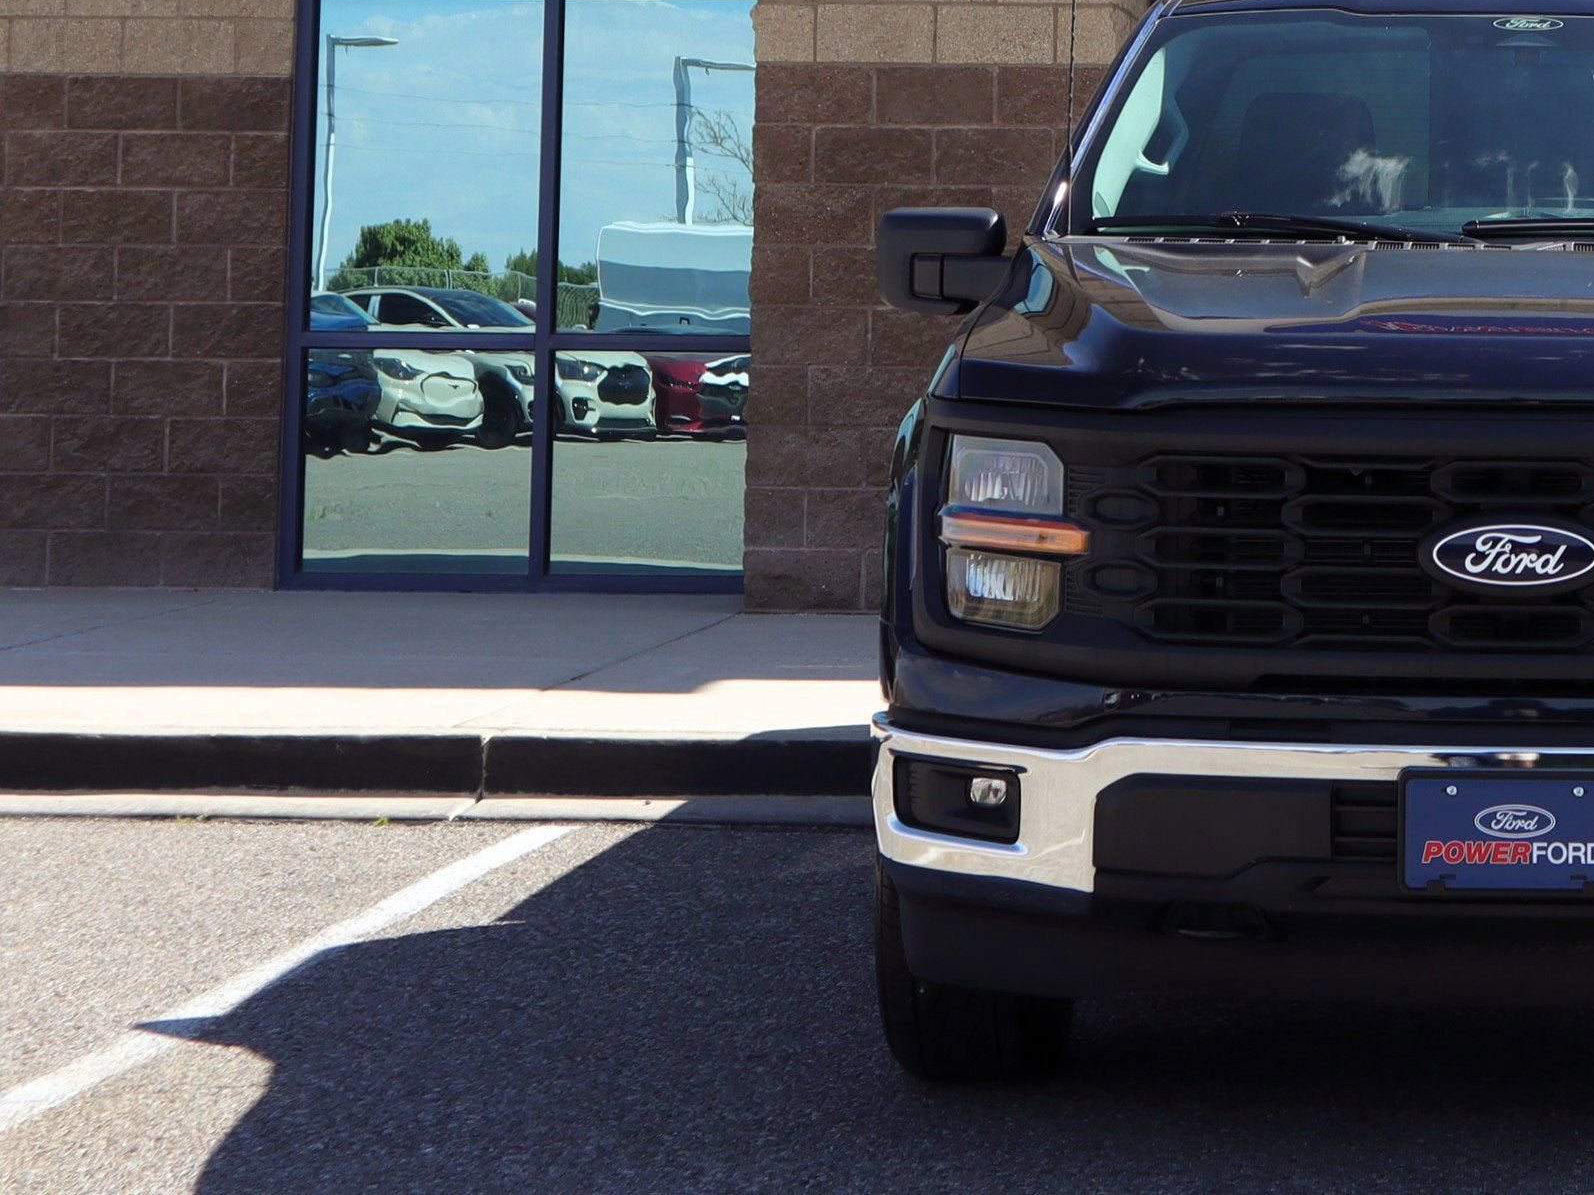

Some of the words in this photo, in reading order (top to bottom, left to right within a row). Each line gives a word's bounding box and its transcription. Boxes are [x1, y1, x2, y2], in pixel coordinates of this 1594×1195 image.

[1505, 16, 1552, 29] Ford
[1464, 532, 1568, 574] Ford
[1490, 810, 1539, 832] Ford
